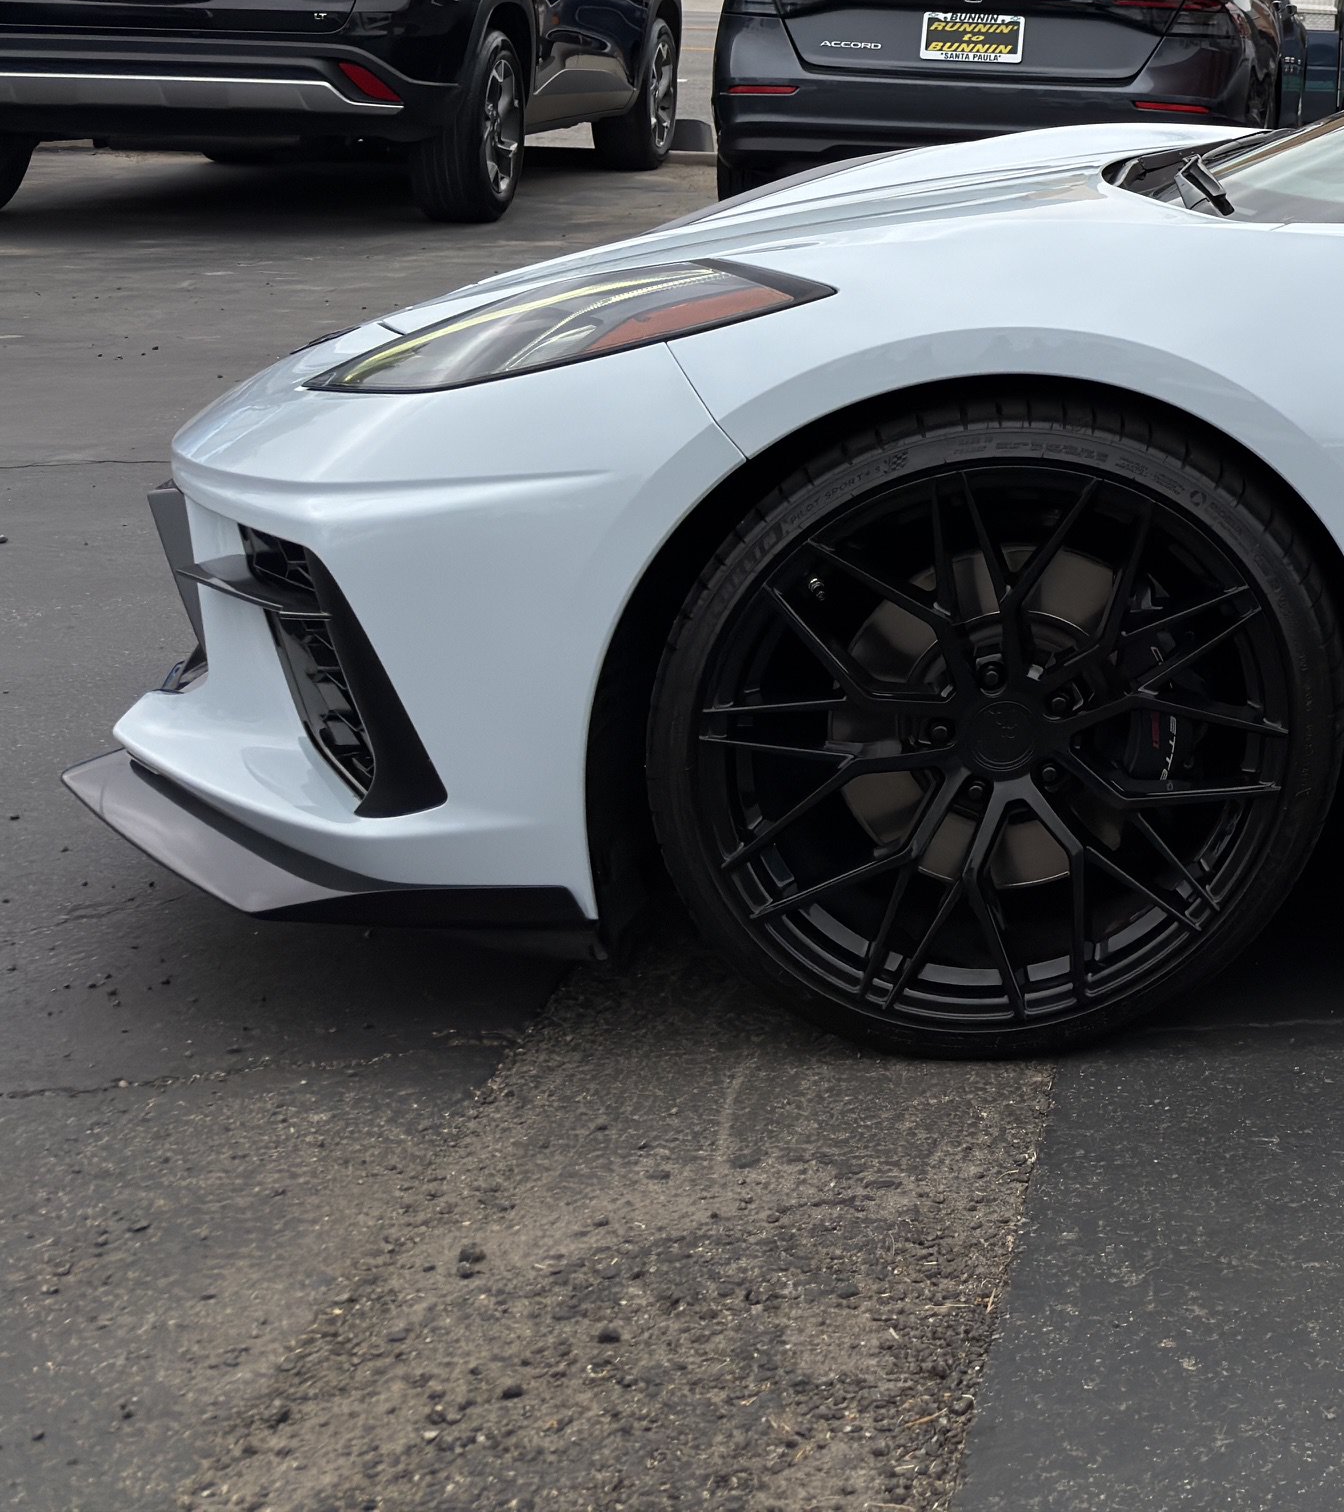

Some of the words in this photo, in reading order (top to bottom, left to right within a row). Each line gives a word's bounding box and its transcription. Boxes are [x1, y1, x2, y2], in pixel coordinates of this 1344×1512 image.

[950, 13, 999, 23] BUNNIN
[929, 21, 1019, 34] RUNNIN'
[962, 33, 985, 41] to
[820, 40, 882, 50] ACCORD
[927, 41, 1013, 54] BUNNIN
